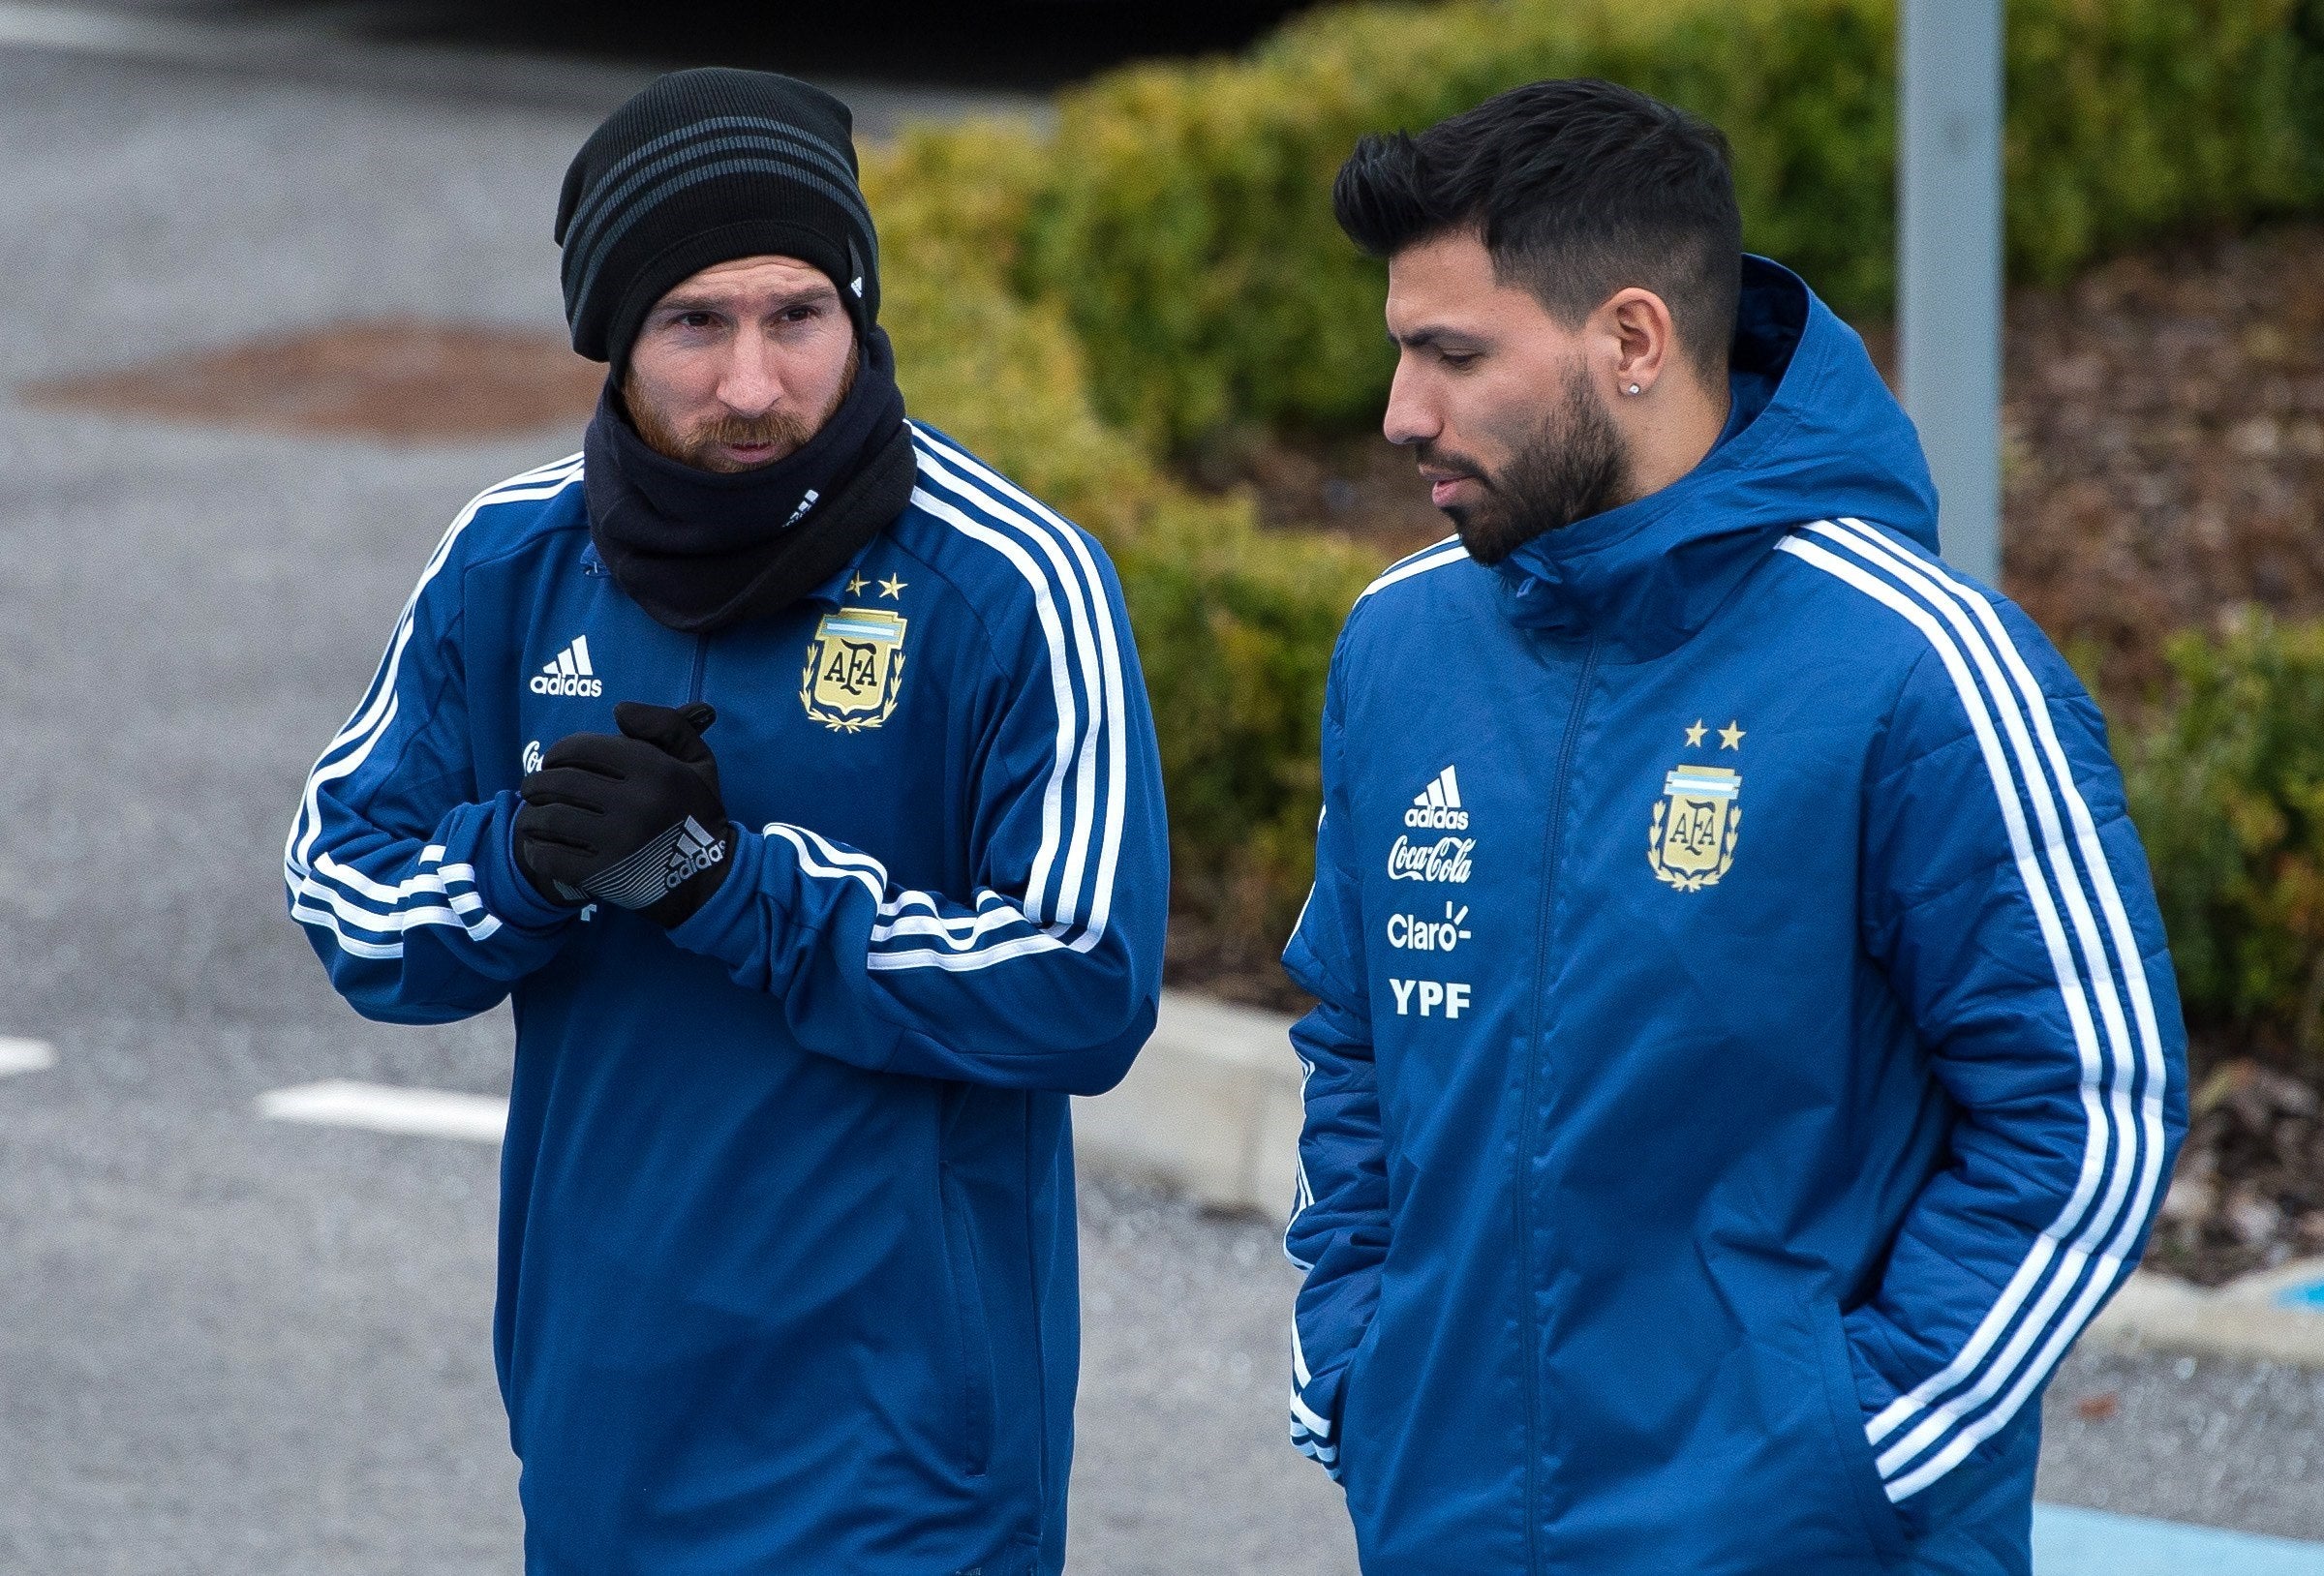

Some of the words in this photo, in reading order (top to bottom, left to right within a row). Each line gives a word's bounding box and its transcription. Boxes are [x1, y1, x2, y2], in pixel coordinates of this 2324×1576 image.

[530, 674, 602, 698] adidas
[823, 637, 878, 696] AFA
[1404, 803, 1469, 831] adidas
[1669, 799, 1716, 857] AFA
[1387, 833, 1477, 885] Coca-Cola
[1389, 978, 1472, 1019] YPF
